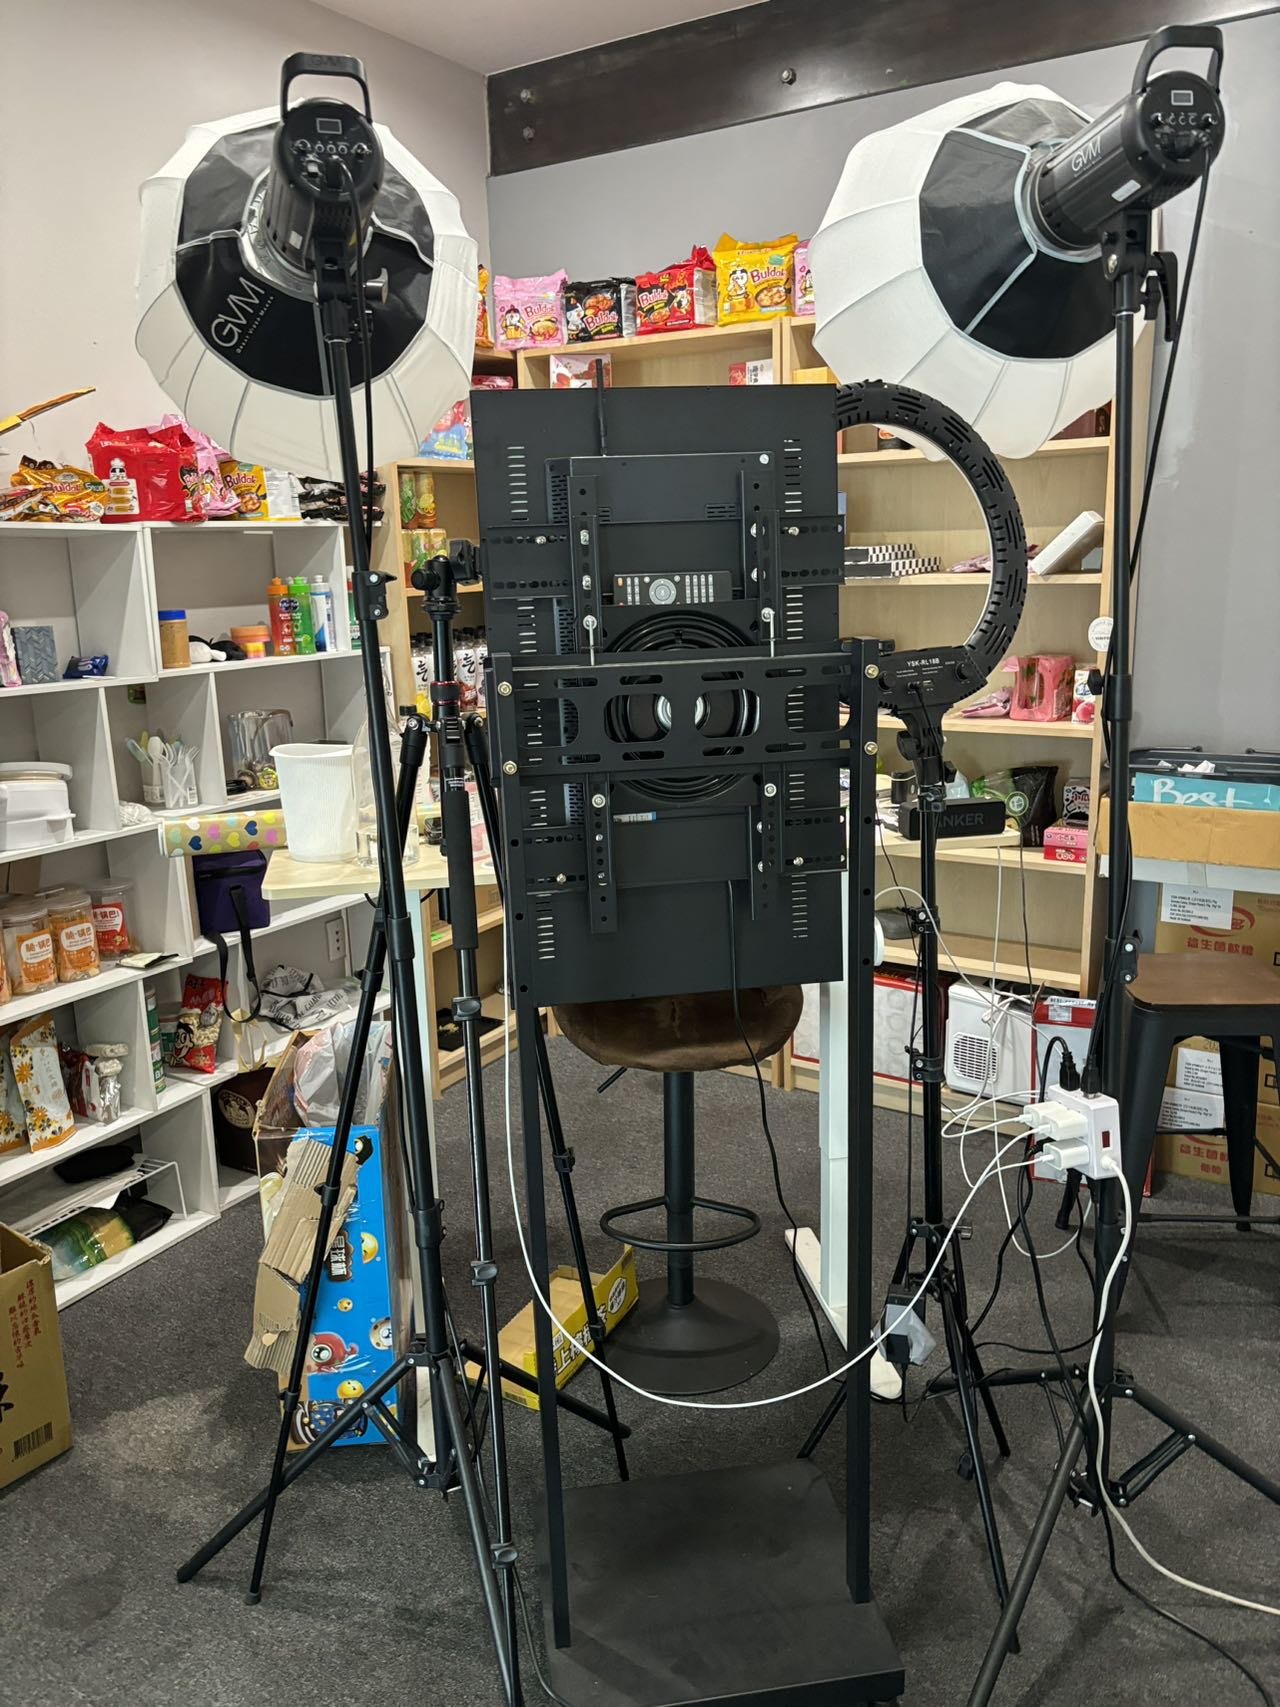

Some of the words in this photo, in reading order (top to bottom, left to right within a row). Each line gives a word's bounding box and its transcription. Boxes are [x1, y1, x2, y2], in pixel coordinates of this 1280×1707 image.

[1071, 136, 1102, 171] GVM
[211, 277, 265, 347] GVM
[224, 473, 257, 489] Buldak
[1151, 778, 1253, 808] Best
